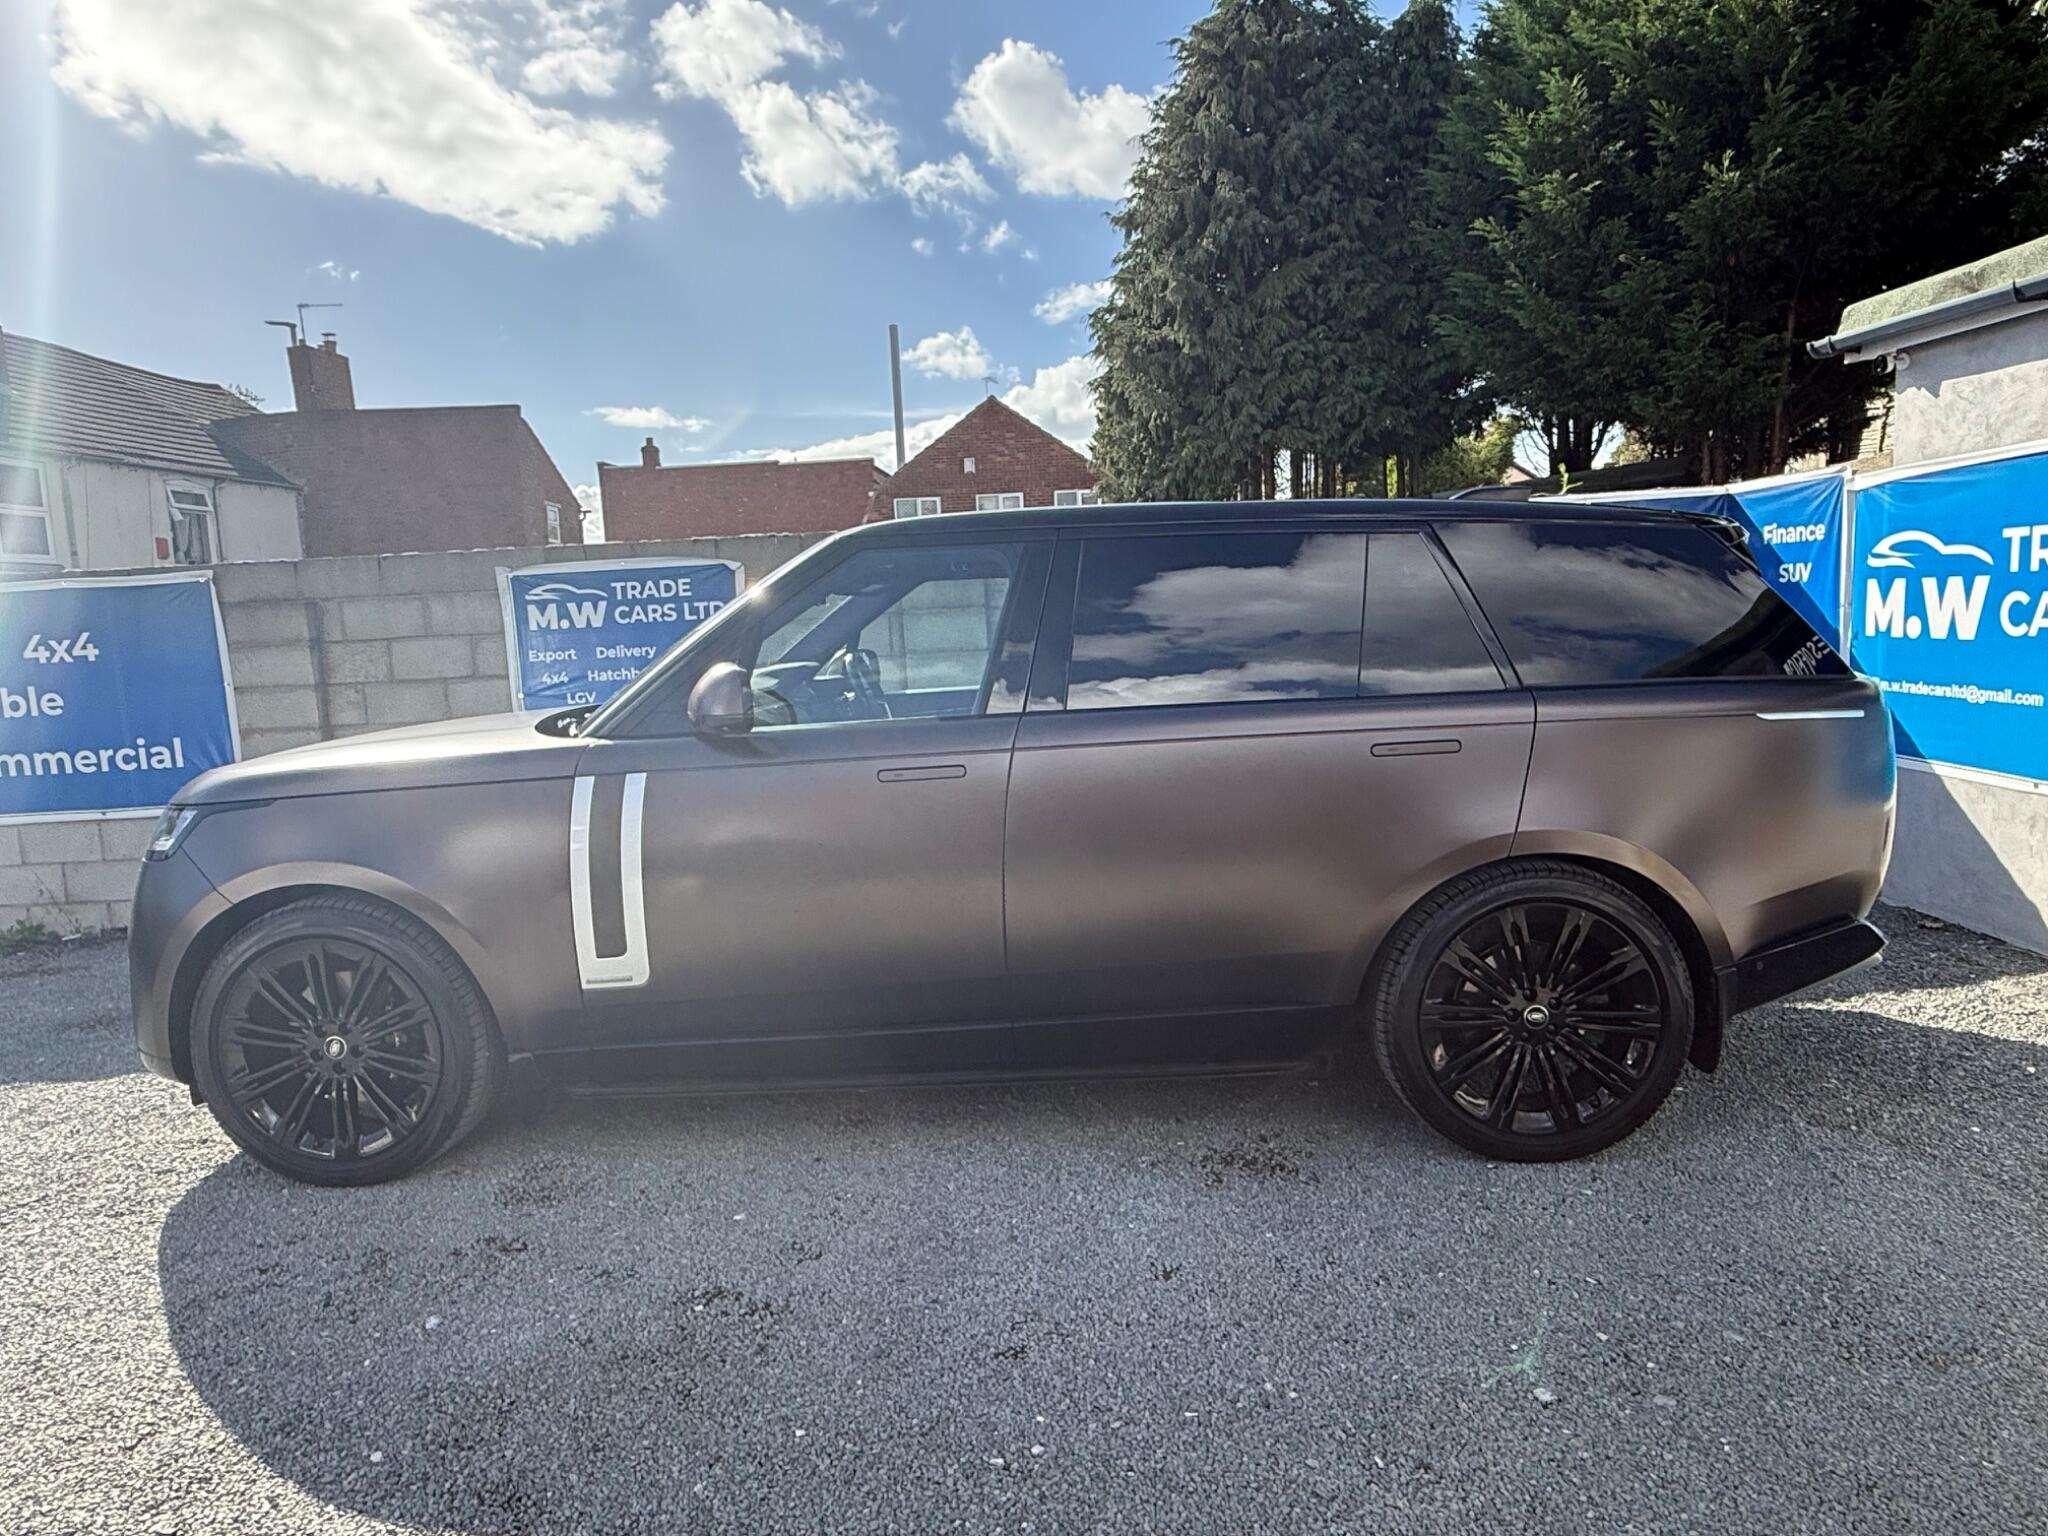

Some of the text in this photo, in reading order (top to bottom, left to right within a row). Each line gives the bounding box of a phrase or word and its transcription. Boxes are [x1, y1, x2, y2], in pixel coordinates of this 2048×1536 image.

[1763, 522, 1826, 545] Finance
[2002, 524, 2048, 573] TR
[1779, 562, 1812, 583] SUV
[610, 578, 692, 600] TRADE
[526, 600, 608, 631] M.W
[614, 603, 678, 624] CARS
[1864, 575, 1991, 640] M.W
[22, 632, 100, 664] 4x4
[528, 648, 578, 664] Export
[595, 645, 657, 660] Delivery
[541, 671, 570, 685] 4x4
[566, 691, 597, 704] LGV
